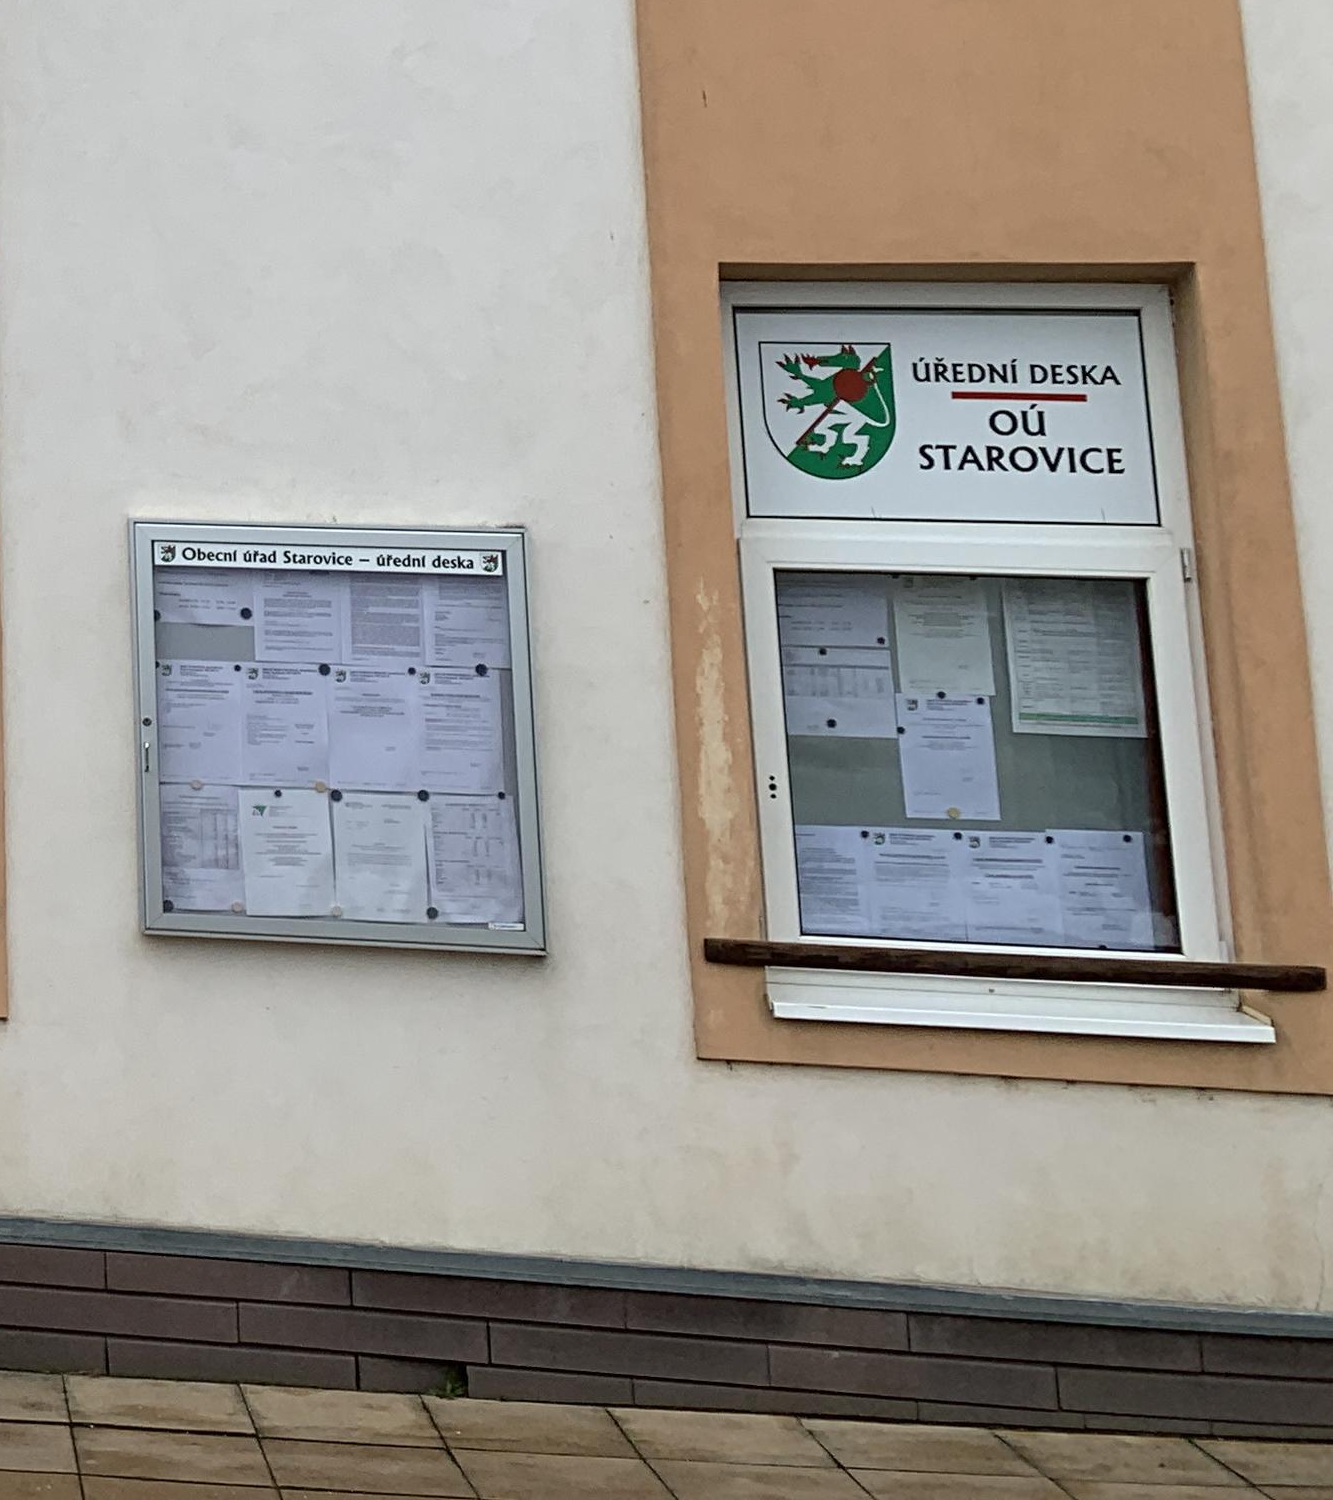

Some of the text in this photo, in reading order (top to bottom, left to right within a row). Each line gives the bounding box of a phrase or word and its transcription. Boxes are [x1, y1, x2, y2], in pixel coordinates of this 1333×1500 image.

[912, 356, 1122, 387] ÚŘEDNÍ DESKA
[988, 404, 1047, 438] OÚ
[918, 444, 1126, 475] STAROVICE
[181, 546, 238, 563] Obecní
[243, 549, 277, 565] úřad
[283, 550, 353, 567] Starovice
[376, 553, 426, 569] úřední
[432, 555, 475, 570] deska
